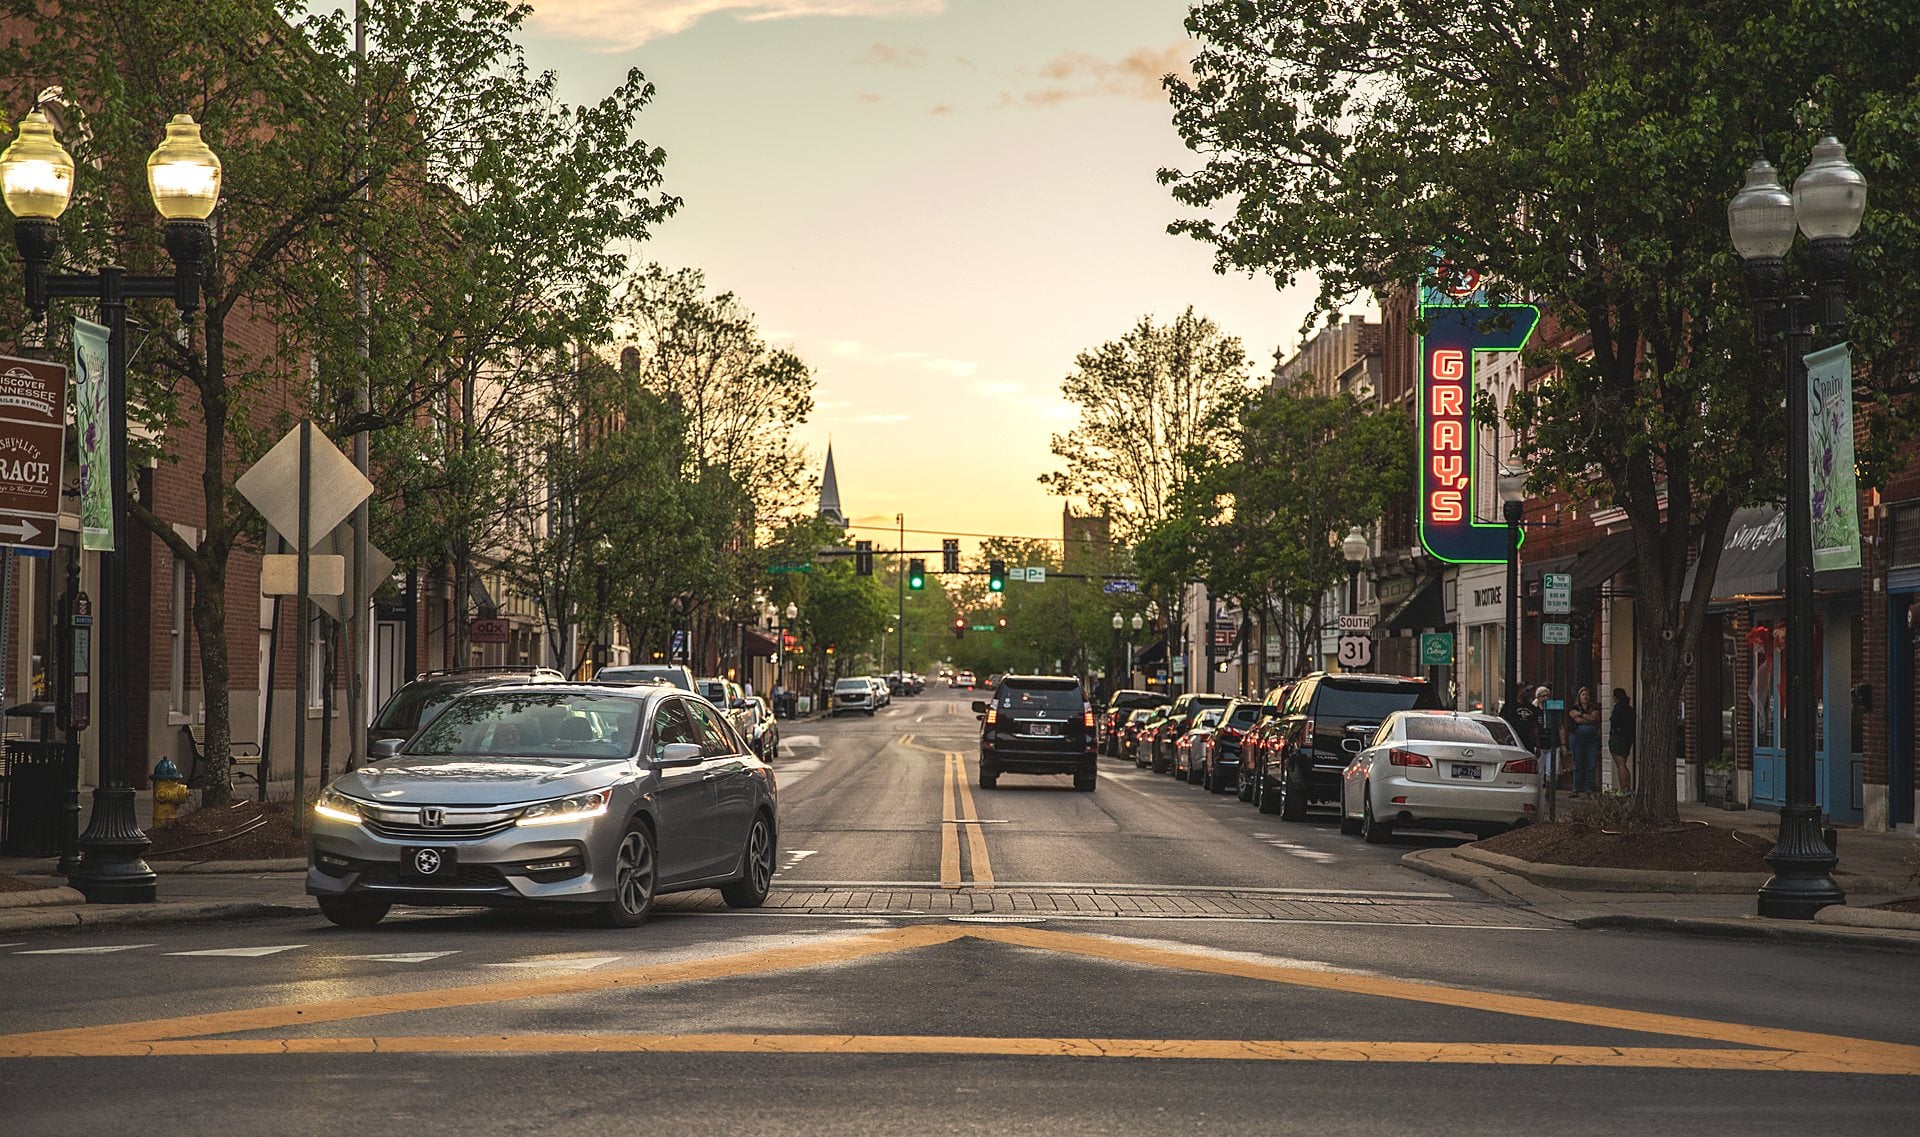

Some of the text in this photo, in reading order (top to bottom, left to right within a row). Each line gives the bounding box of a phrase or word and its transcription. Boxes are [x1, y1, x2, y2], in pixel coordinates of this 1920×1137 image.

[0, 377, 46, 390] ISCOVER
[0, 386, 57, 404] NNESSEE
[1432, 350, 1468, 521] GRAY'S
[0, 437, 41, 459] SHVILLE'S
[0, 458, 50, 484] RACE
[1546, 577, 1552, 587] 2
[1340, 617, 1370, 628] SOUTH
[1345, 641, 1364, 659] 31
